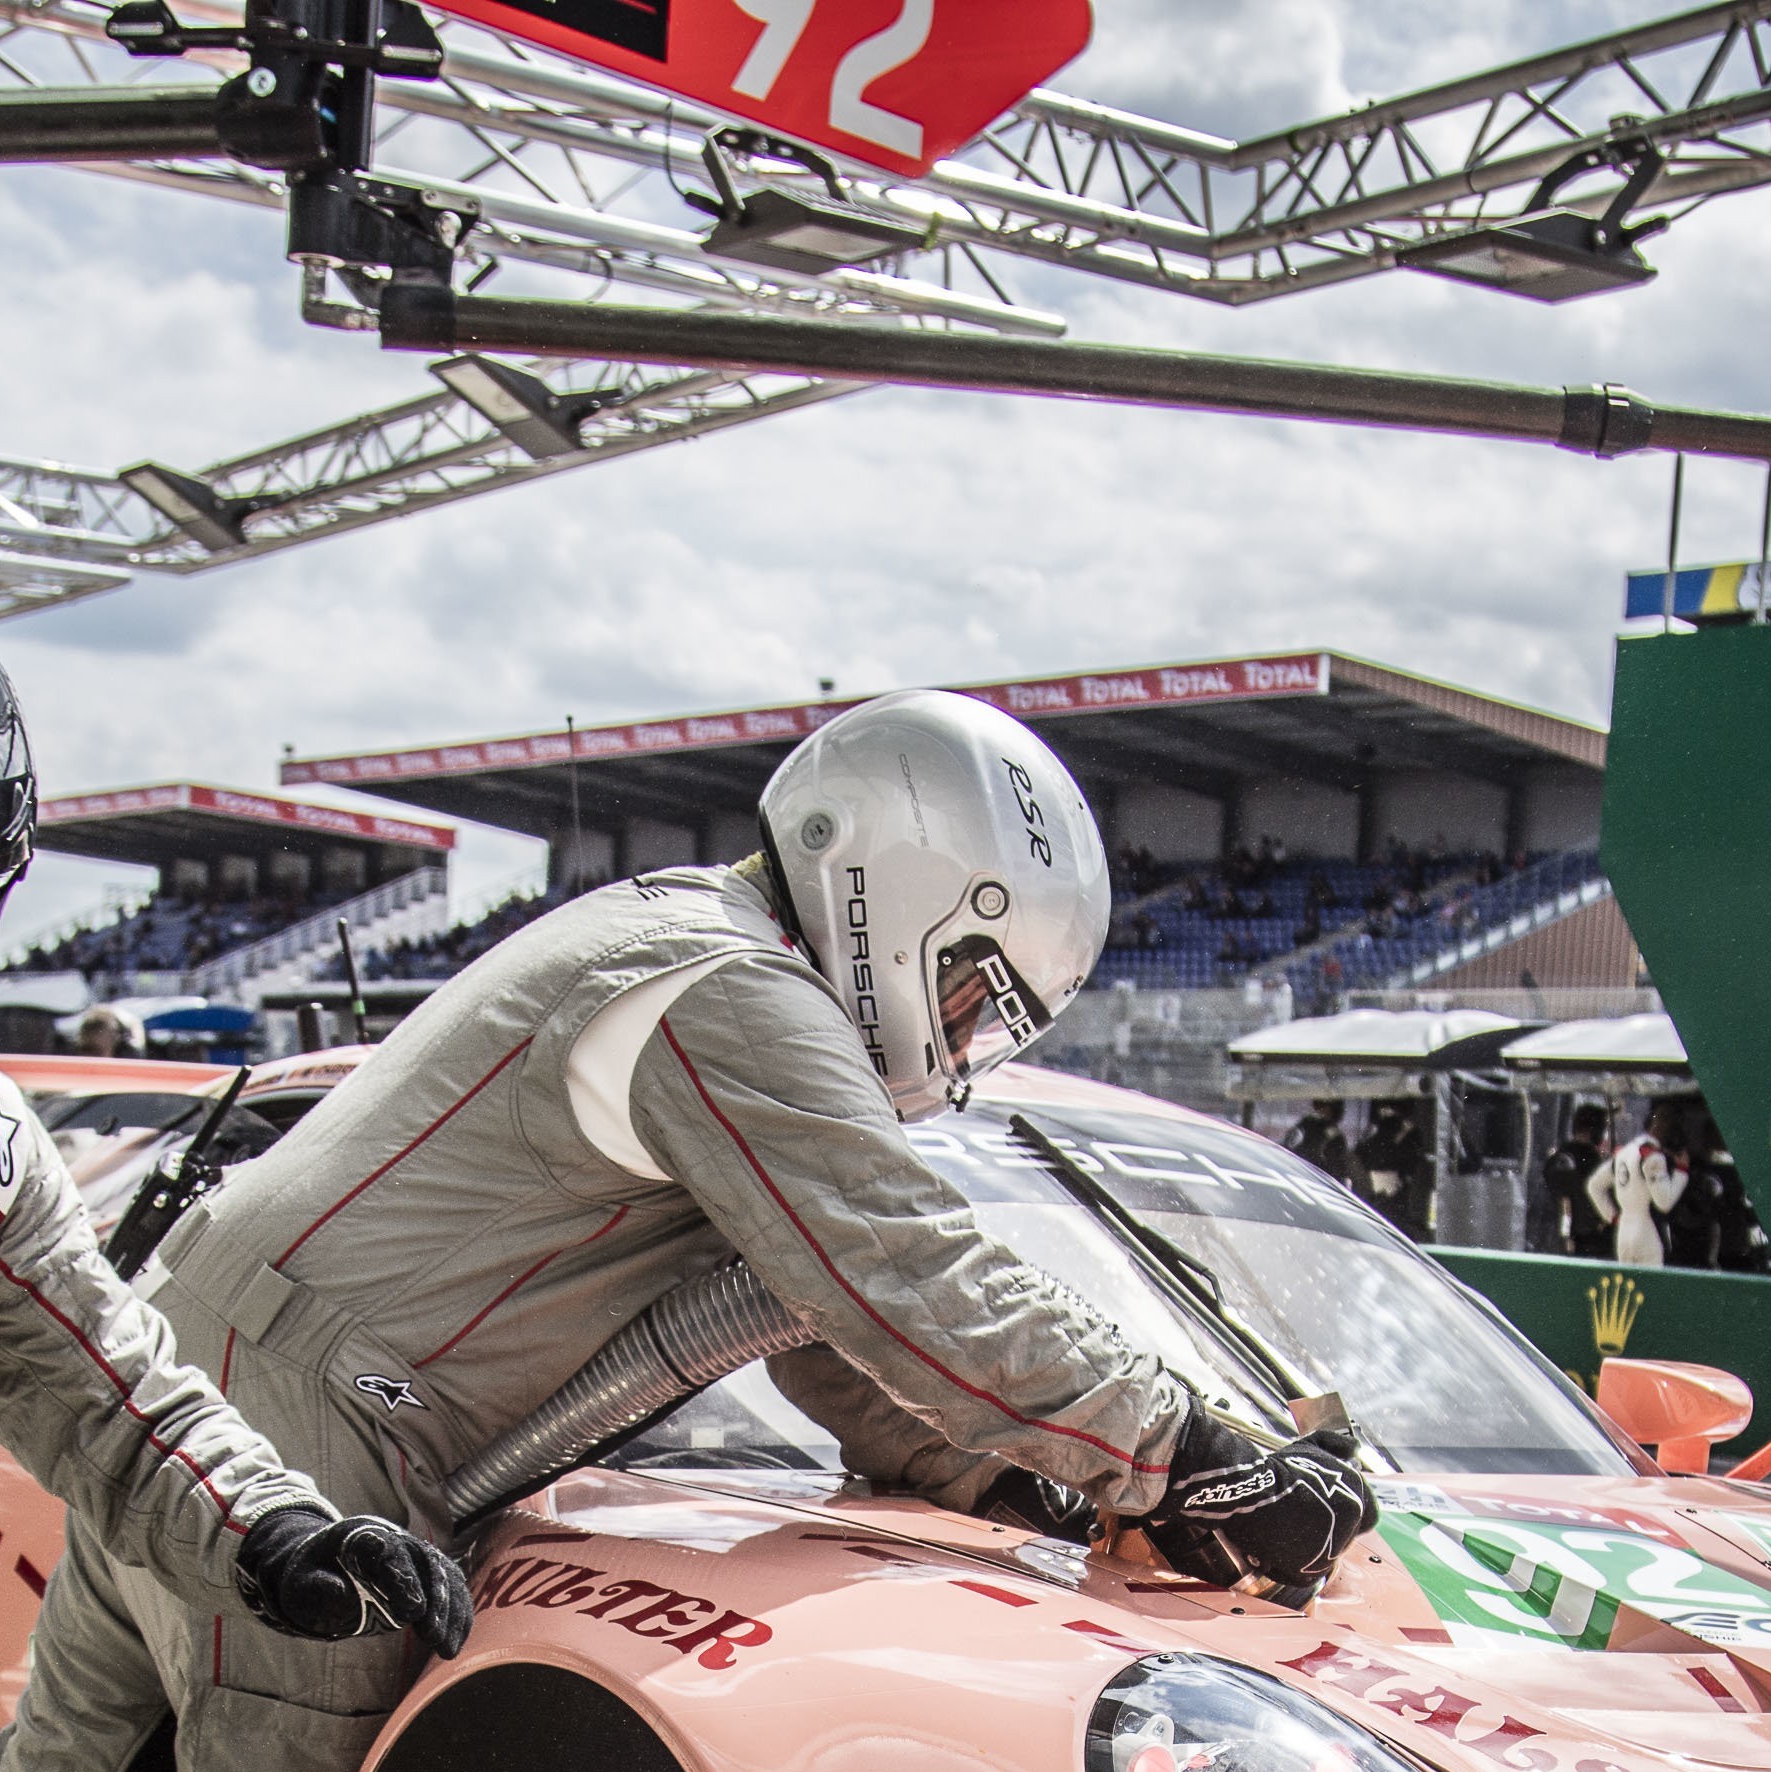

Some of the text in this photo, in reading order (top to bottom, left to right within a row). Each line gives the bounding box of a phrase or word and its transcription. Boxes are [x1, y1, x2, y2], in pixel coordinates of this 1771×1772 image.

[1008, 684, 1074, 708] TOTAL
[1080, 676, 1151, 702] TOTAL
[1159, 668, 1233, 696] TOTAL
[1243, 661, 1318, 689] TOTAL
[1001, 756, 1053, 868] RSR
[845, 866, 889, 1077] PORSCHE
[976, 953, 1038, 1047] POR
[1419, 1517, 1771, 1637] 92
